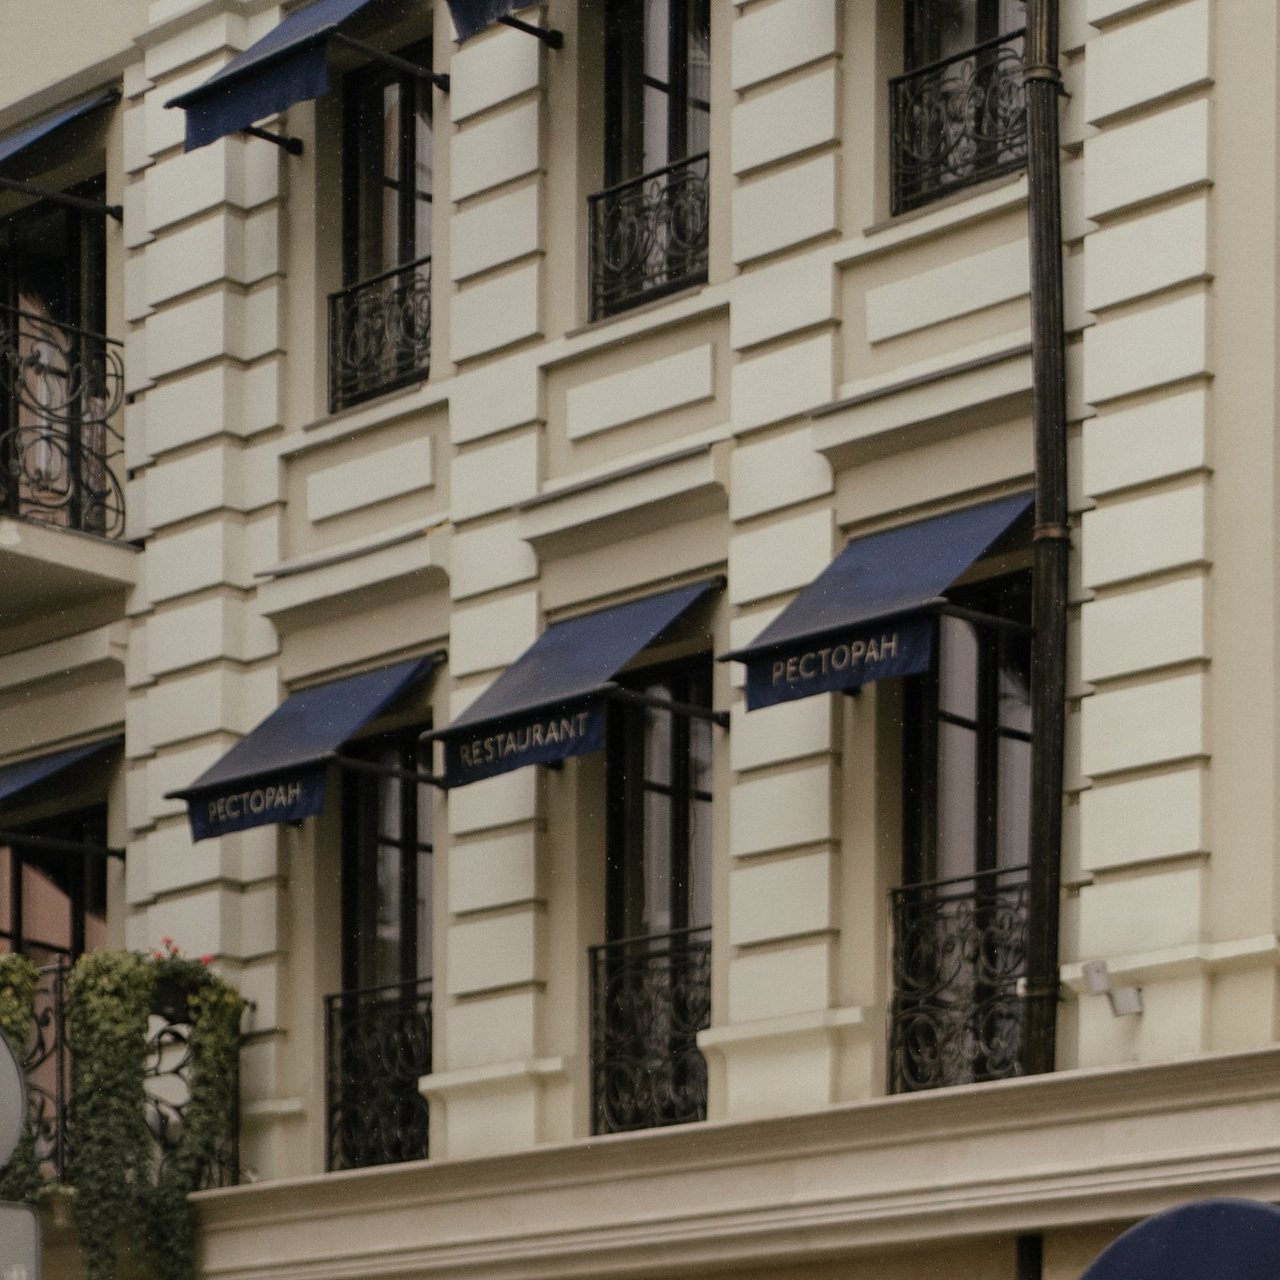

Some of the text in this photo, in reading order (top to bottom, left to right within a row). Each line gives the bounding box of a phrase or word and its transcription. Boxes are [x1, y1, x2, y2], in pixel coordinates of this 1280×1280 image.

[772, 632, 899, 687] РЕСТОРАН
[460, 712, 590, 769] RESTAURANT
[208, 781, 303, 824] РЕСТОРАН
